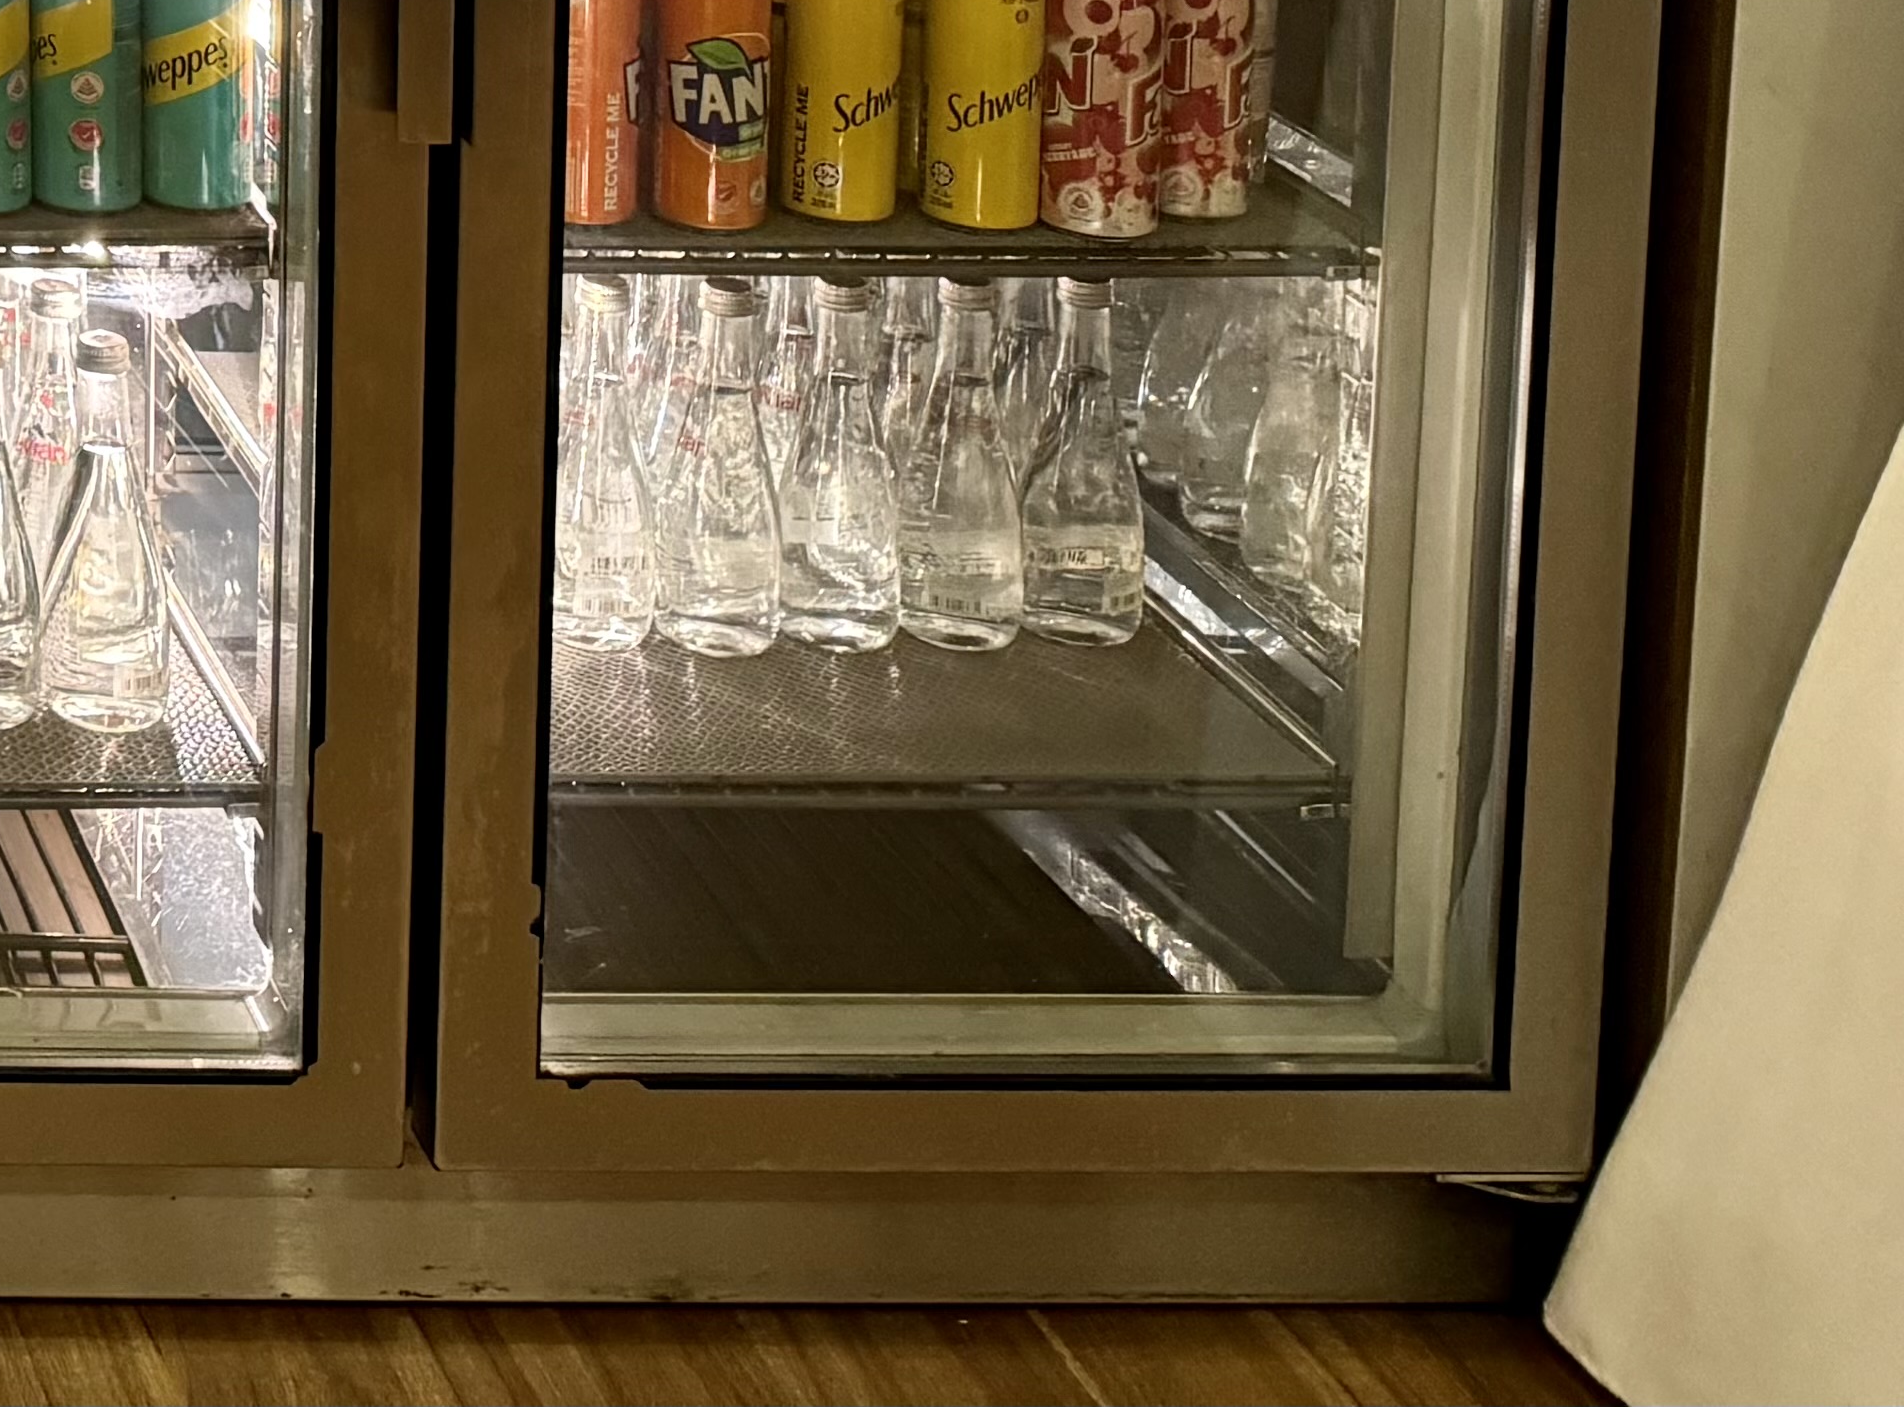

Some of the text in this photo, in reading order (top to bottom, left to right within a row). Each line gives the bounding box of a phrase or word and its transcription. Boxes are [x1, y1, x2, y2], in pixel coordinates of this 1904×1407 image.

[669, 60, 770, 125] FAN
[604, 92, 621, 213] RECYCLE ME
